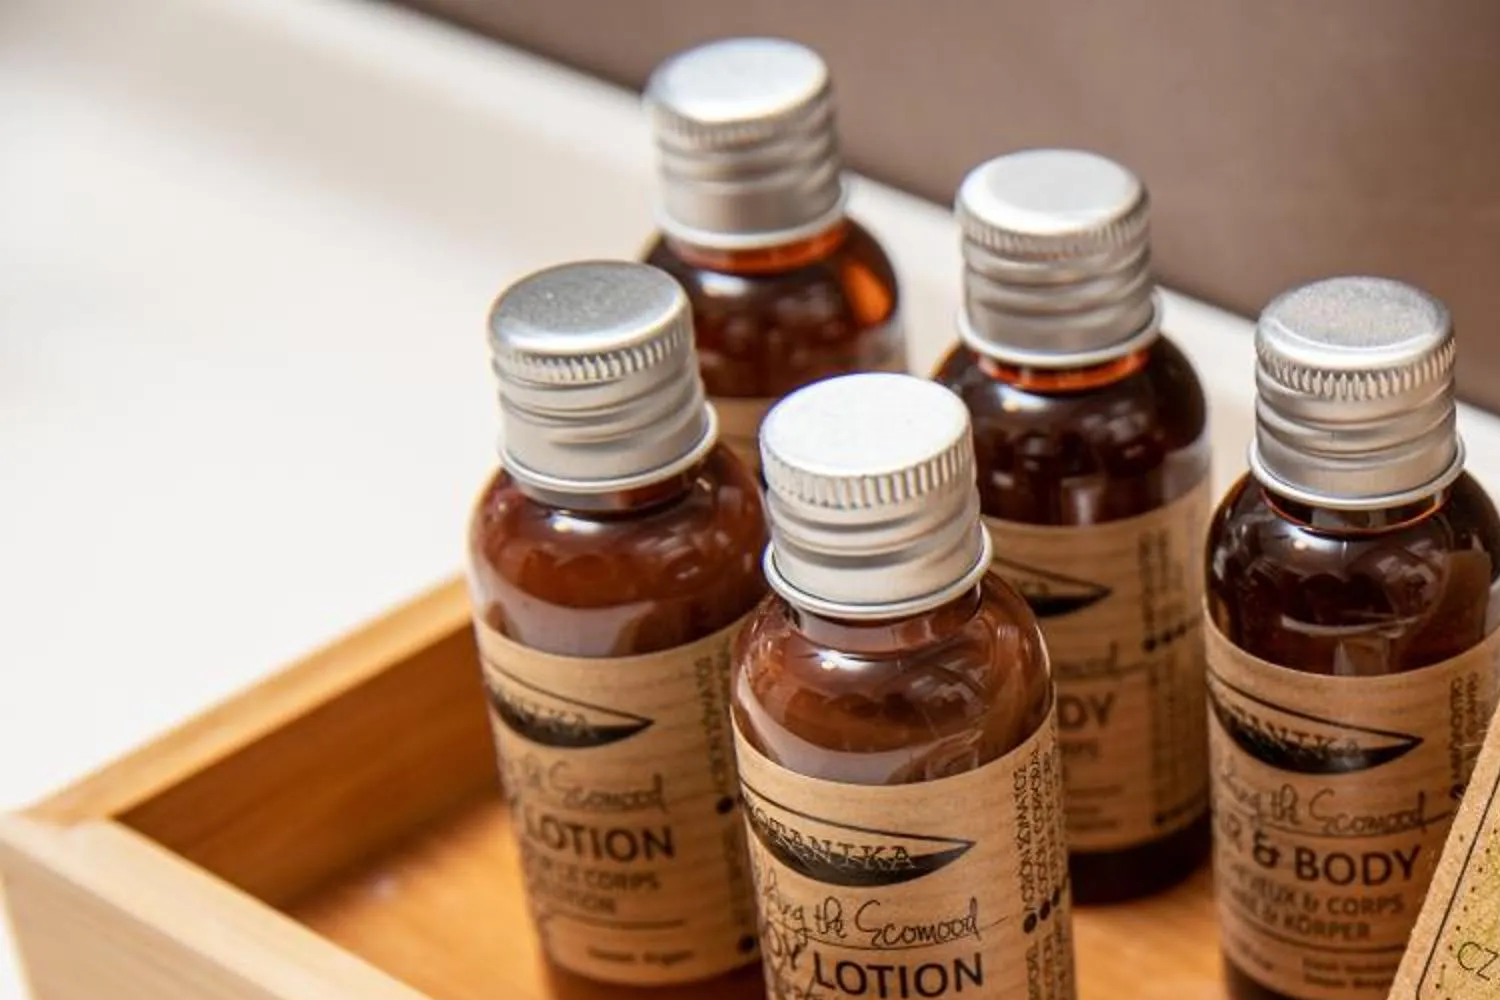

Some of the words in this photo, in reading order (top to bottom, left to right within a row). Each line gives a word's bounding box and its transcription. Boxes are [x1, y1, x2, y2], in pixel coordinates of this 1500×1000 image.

[524, 812, 676, 863] LOTION
[1295, 845, 1421, 886] BODY
[813, 951, 983, 999] LOTION
